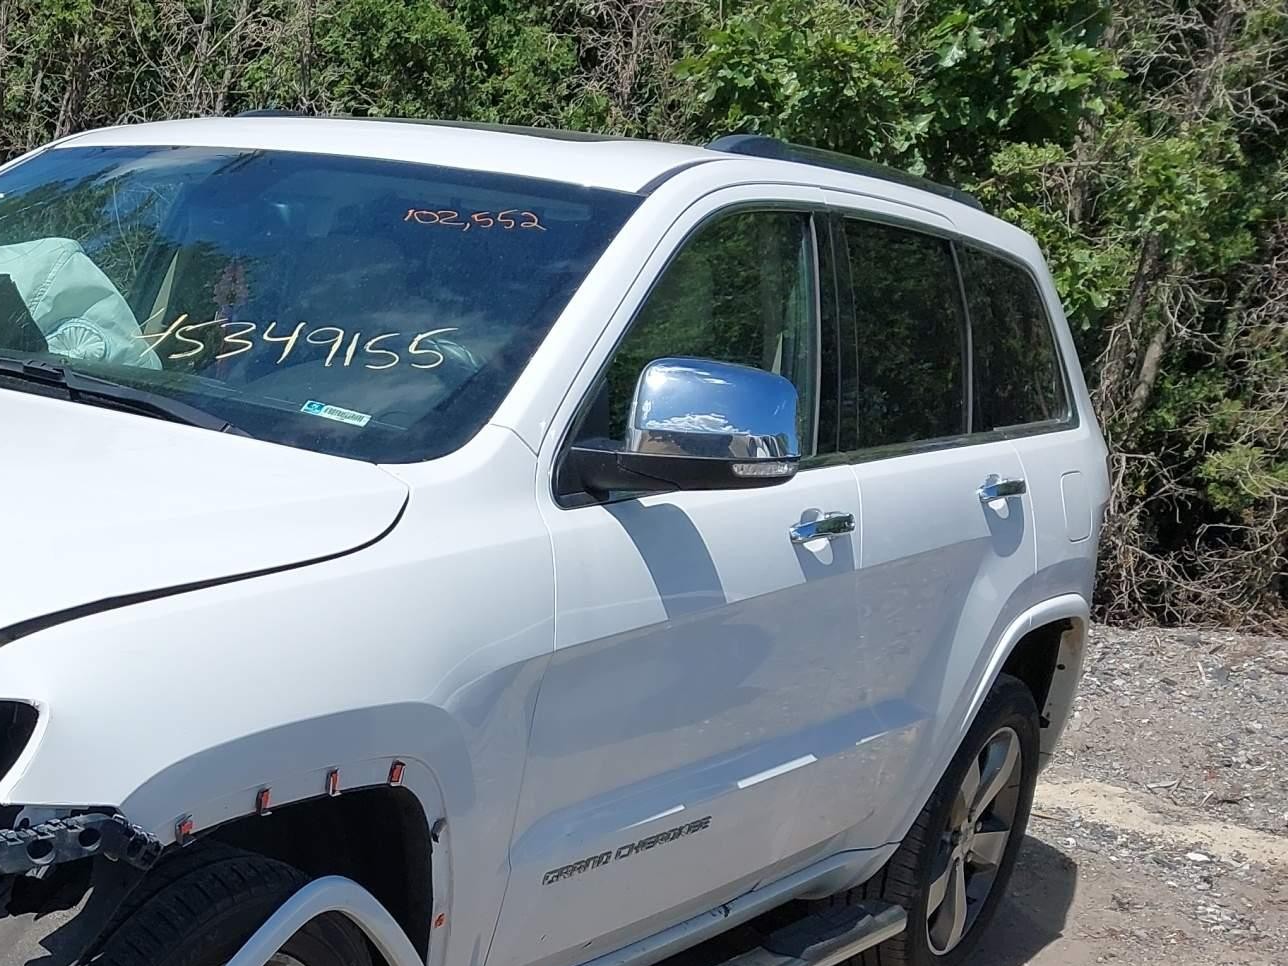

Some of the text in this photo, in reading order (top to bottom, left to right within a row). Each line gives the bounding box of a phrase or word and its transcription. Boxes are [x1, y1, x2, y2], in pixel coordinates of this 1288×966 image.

[404, 208, 547, 232] 102,552
[131, 308, 459, 370] 45349155
[541, 815, 713, 886] GRAND CHEROKEE
